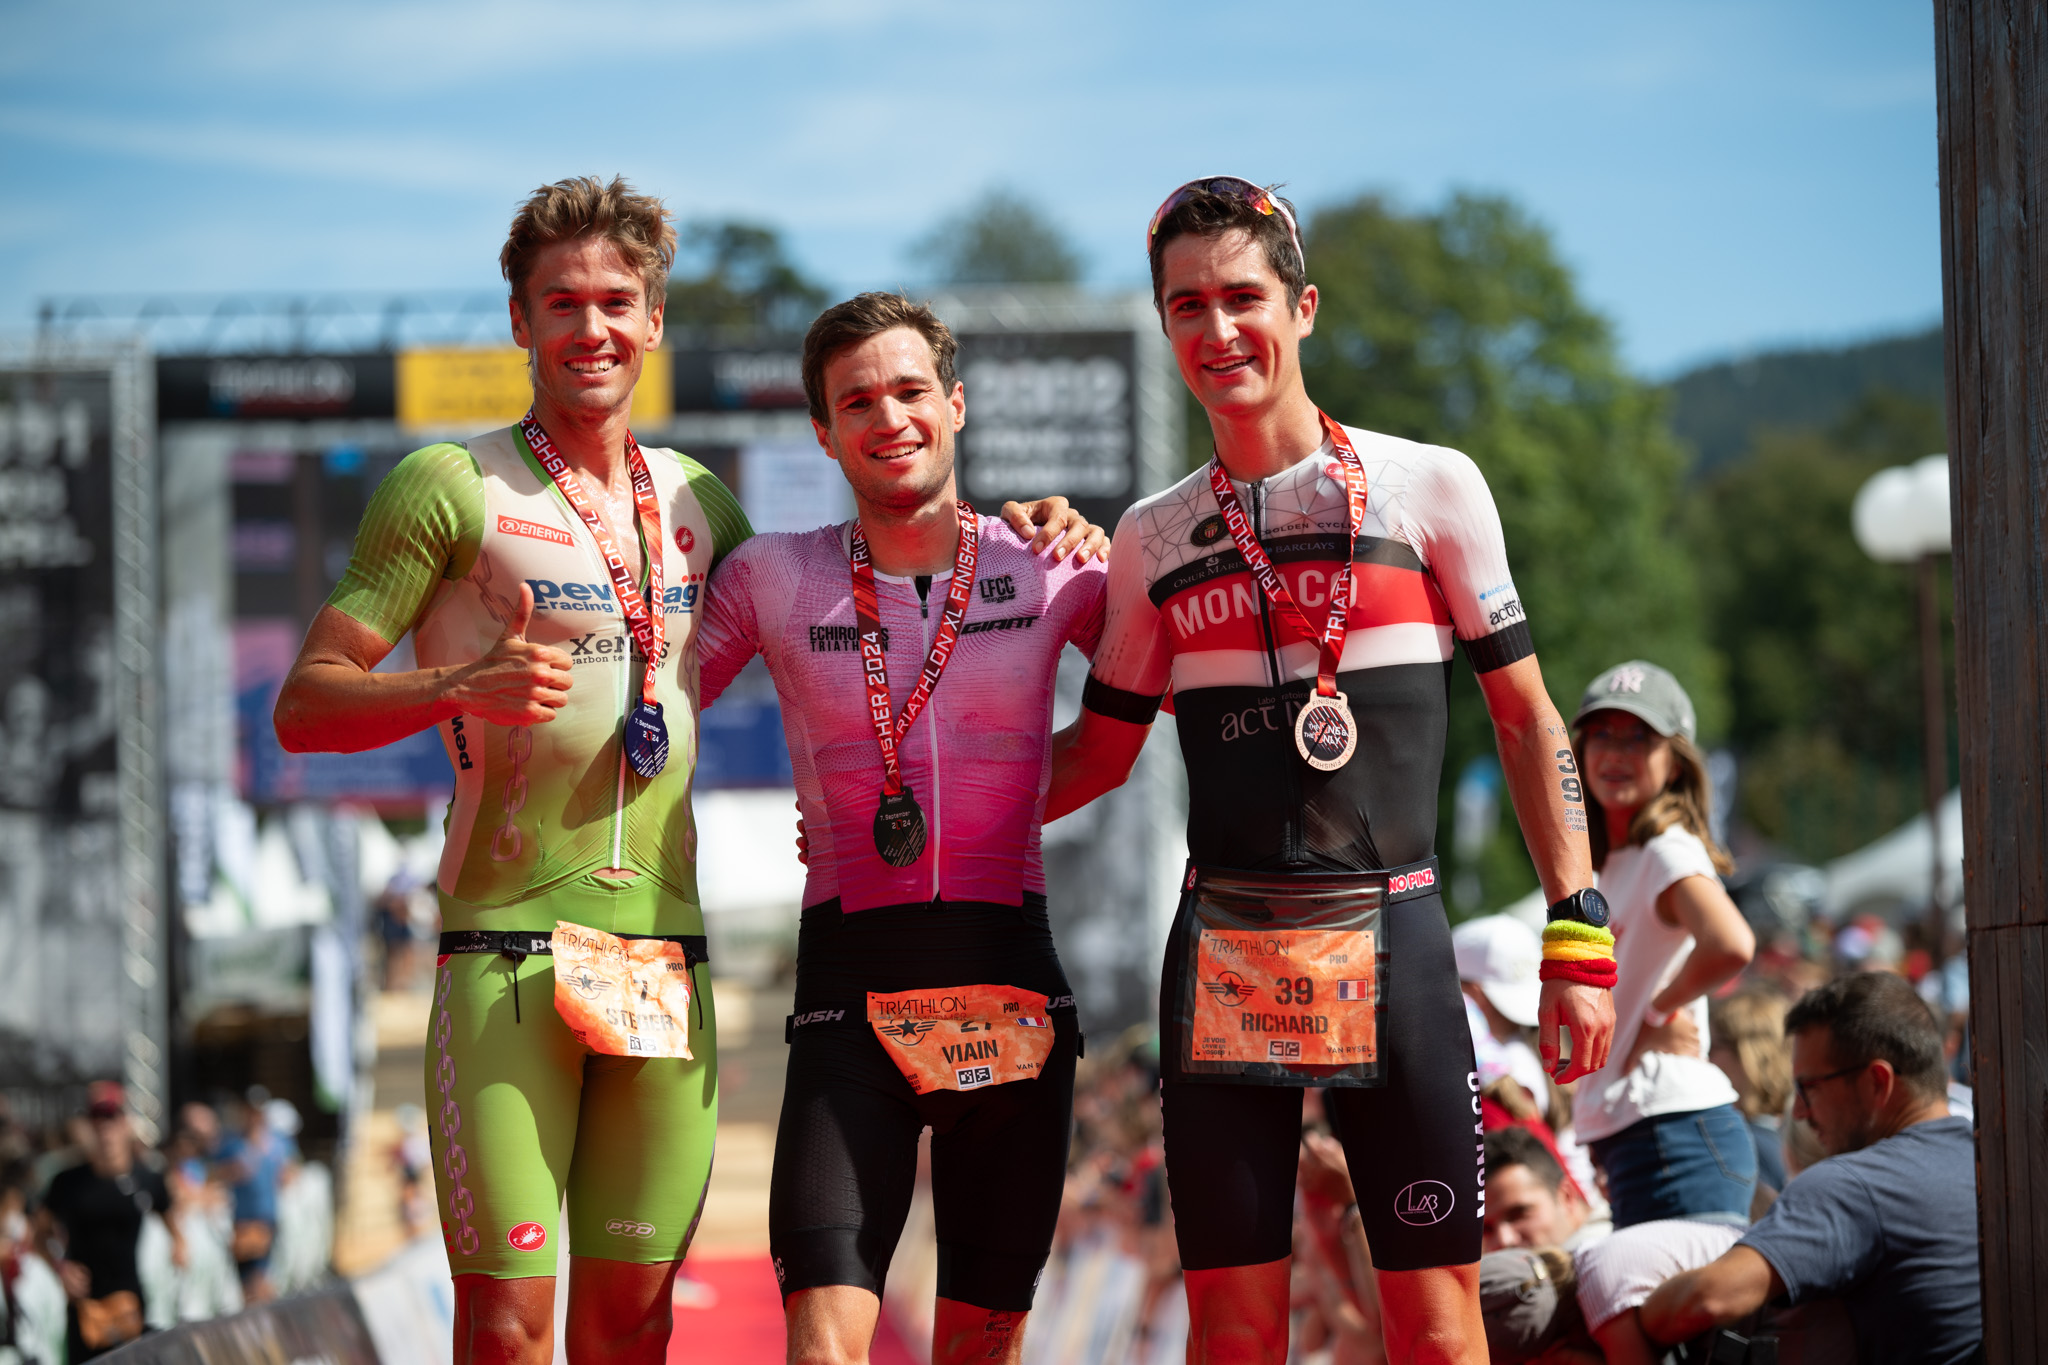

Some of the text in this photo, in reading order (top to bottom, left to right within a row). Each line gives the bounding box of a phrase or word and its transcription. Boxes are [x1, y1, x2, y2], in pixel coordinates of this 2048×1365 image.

[628, 434, 653, 504] TRIATHL
[1336, 444, 1366, 538] TRIATHLON
[520, 523, 570, 543] ENERVIT
[1215, 474, 1281, 602] TRIATHLON XL
[1265, 520, 1361, 535] GOLDEN CYCL
[525, 423, 652, 657] TRIATHLON XL FINISHER
[1275, 542, 1335, 553] BARCLAYS
[950, 520, 977, 602] FINISHER
[1207, 561, 1249, 576] MARIN
[979, 575, 1015, 598] LFCC
[549, 601, 614, 613] racing
[1171, 570, 1358, 640] MONCO
[646, 563, 663, 684] SHER 2024
[943, 608, 963, 631] XL
[960, 615, 1040, 635] GIANT
[810, 626, 889, 641] ECHIROS
[569, 633, 671, 659] XeNS
[810, 641, 888, 652] TRIATHN
[862, 631, 886, 686] 2024
[895, 633, 954, 739] RIATHLON
[1312, 698, 1343, 710] FINISHER
[639, 719, 661, 733] September
[871, 693, 898, 775] NISHER
[1343, 710, 1356, 752] TRIATHLON
[451, 715, 473, 770] pew
[1311, 759, 1342, 770] FINISHER
[1556, 749, 1583, 803] 39
[885, 811, 911, 821] September
[1388, 868, 1434, 894] NO PINZ
[560, 931, 630, 962] TRIATHLON
[1210, 938, 1290, 956] TRIATHLON
[666, 962, 684, 972] PRO
[1208, 953, 1222, 965] DE
[1329, 954, 1348, 964] PRO
[1275, 976, 1314, 1006] 39
[876, 995, 967, 1015] TRIATHLON
[1003, 1002, 1020, 1013] PRO
[606, 1007, 675, 1031] STEGER
[793, 1010, 846, 1029] RUSH
[1241, 1012, 1328, 1034] RICHARD
[941, 1039, 999, 1064] VIAIN
[1346, 1045, 1371, 1053] RYSEL
[608, 1222, 653, 1235] PTO
